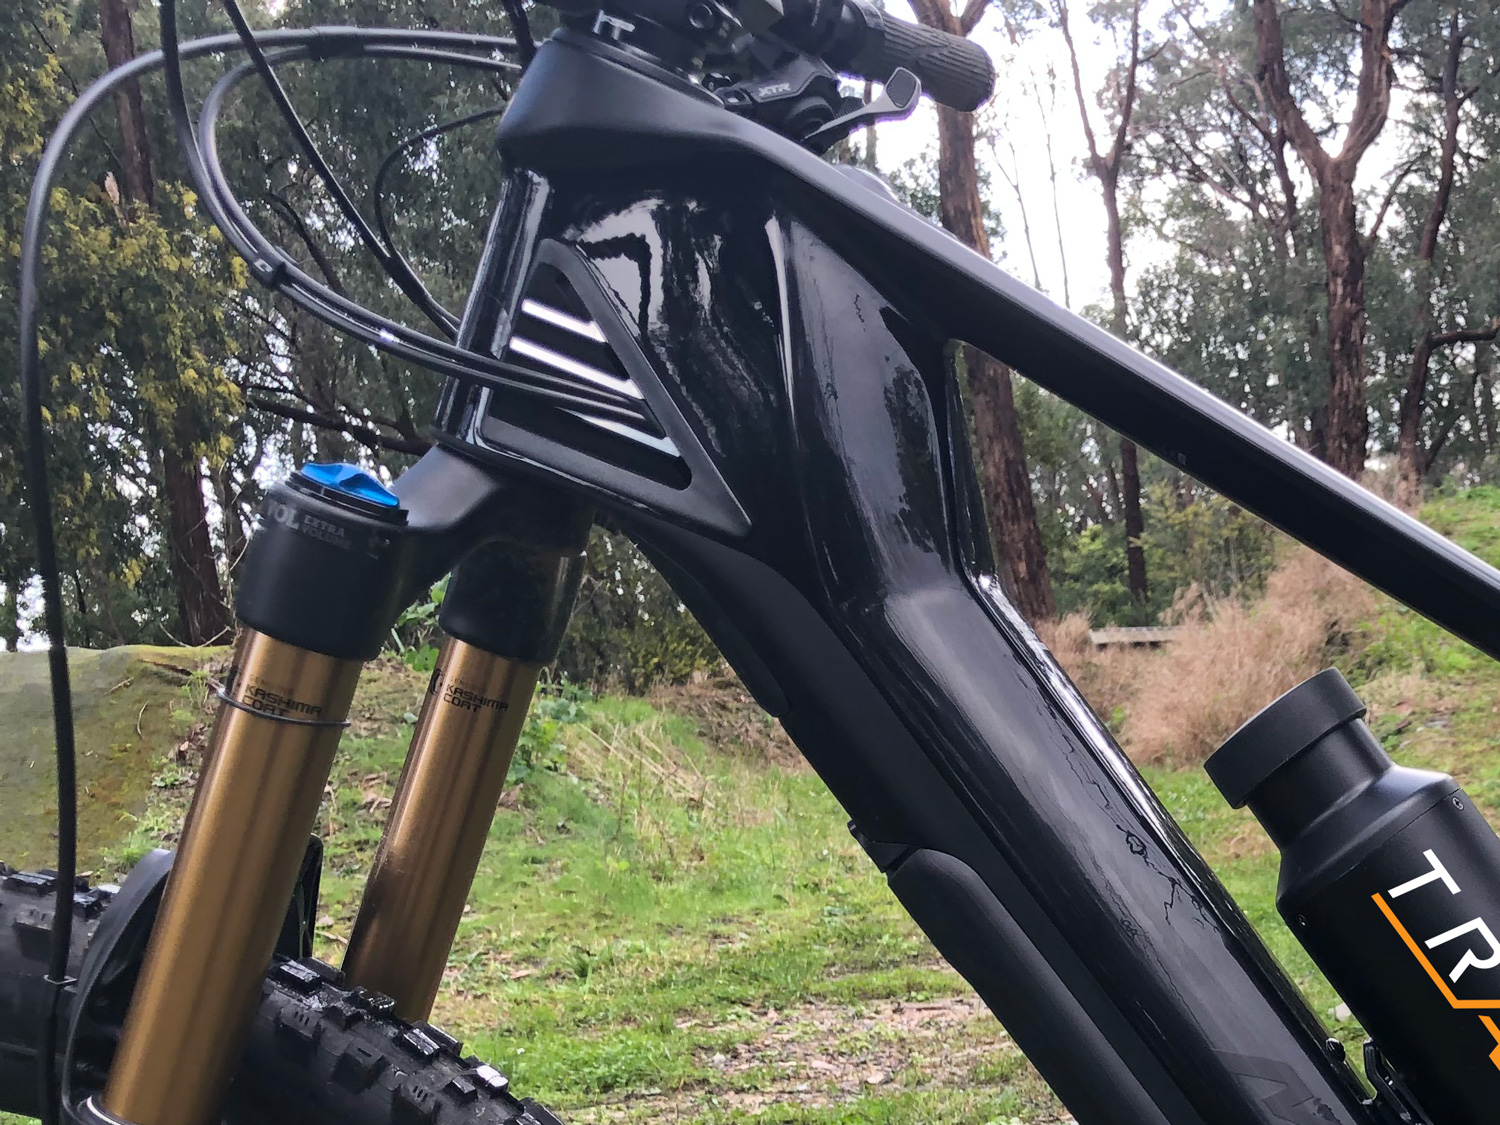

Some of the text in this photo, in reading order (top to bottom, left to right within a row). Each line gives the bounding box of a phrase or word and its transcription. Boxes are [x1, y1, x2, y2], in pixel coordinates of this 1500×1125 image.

[758, 82, 792, 97] XTR
[244, 683, 322, 718] KASHIMA
[443, 692, 482, 713] COAT
[446, 683, 509, 712] KASHIMA
